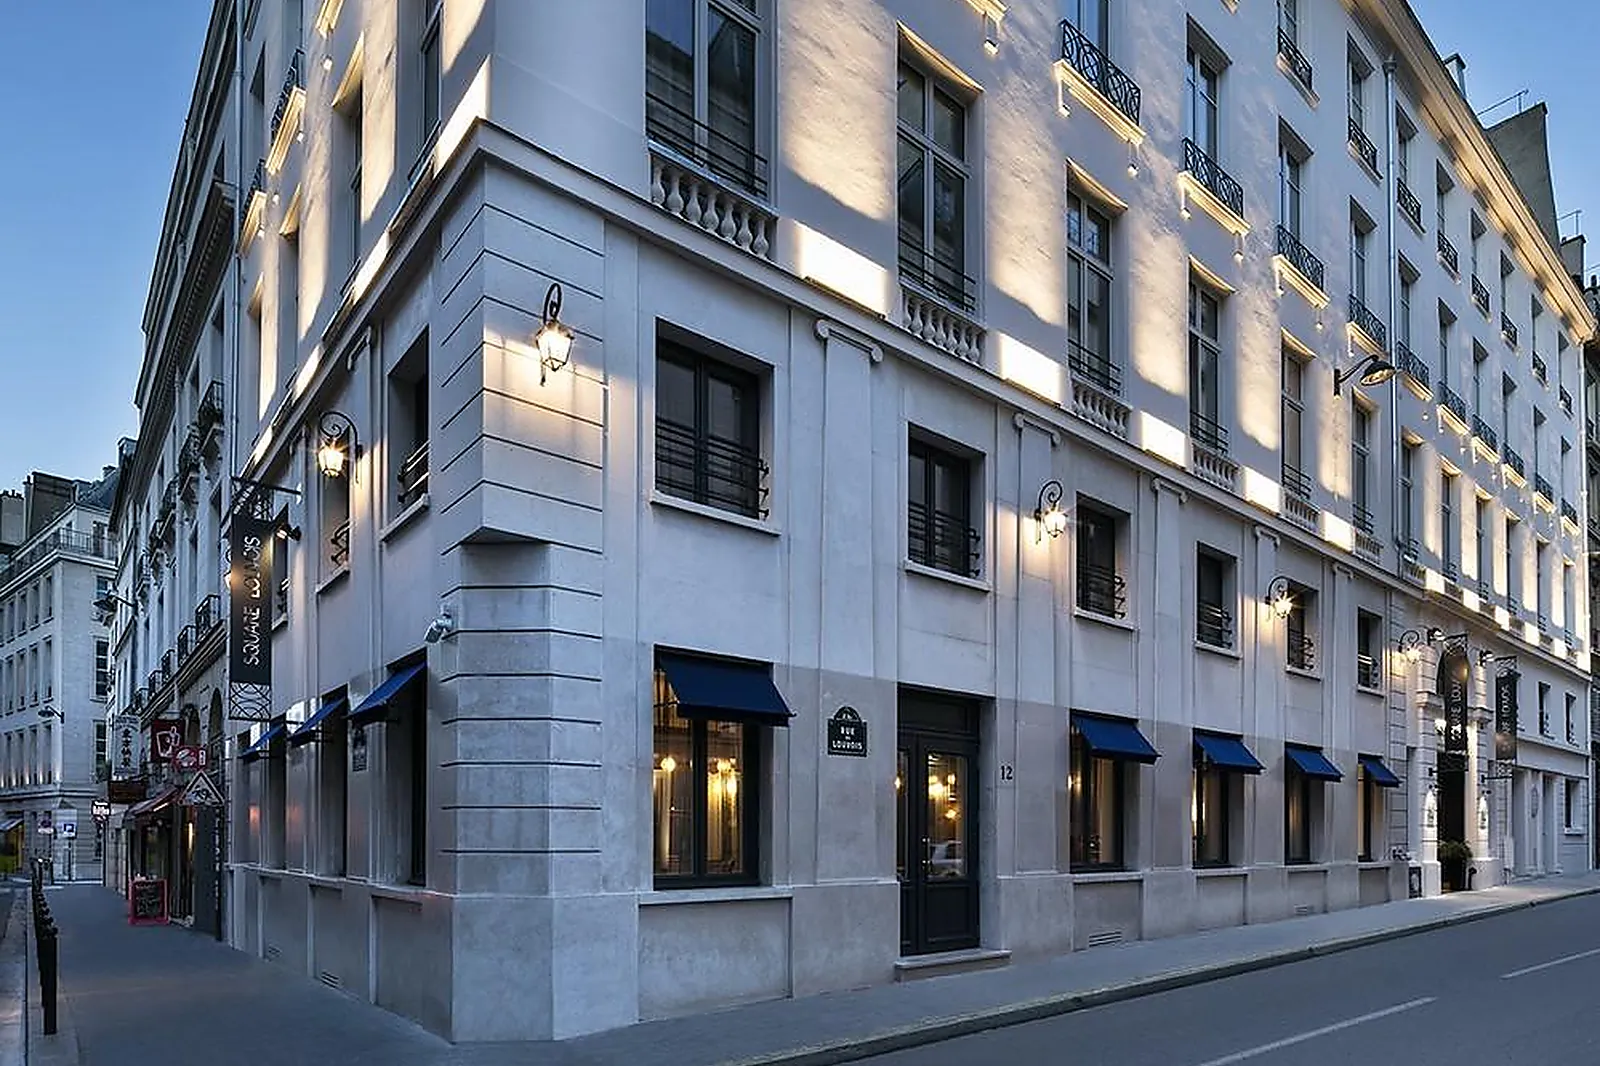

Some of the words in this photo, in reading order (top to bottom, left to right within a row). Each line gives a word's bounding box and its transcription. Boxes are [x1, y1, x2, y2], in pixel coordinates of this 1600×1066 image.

[243, 607, 261, 666] SQUARE
[840, 726, 855, 735] RUE
[832, 740, 863, 750] LOUVOIS
[1001, 765, 1013, 780] 12
